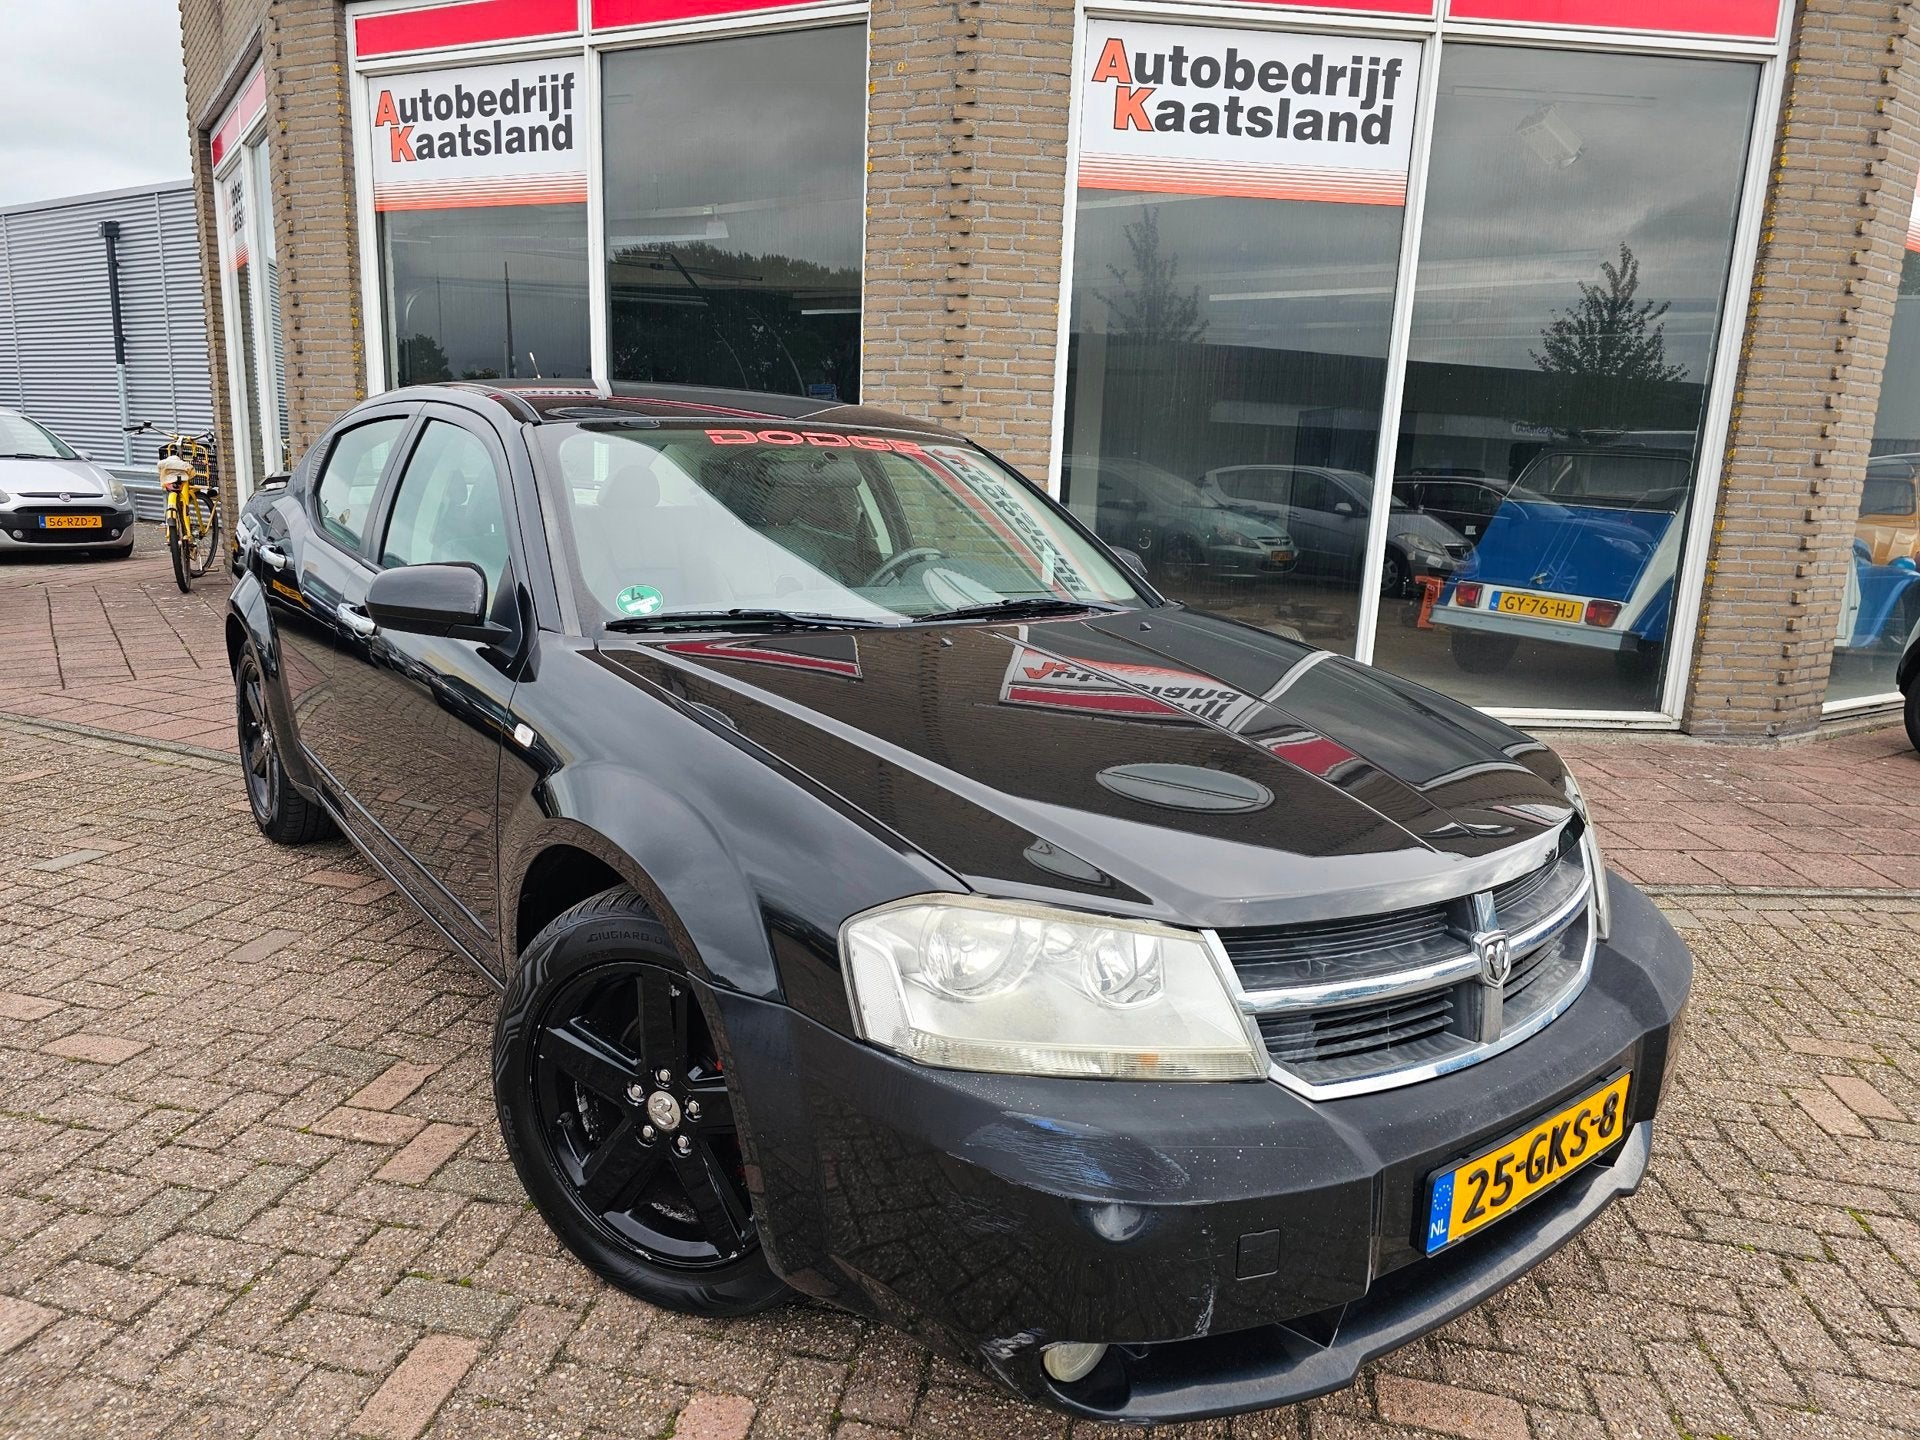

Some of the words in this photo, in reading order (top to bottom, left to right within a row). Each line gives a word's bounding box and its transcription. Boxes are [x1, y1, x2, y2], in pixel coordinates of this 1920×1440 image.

[1091, 38, 1402, 109] Autobedrijf
[375, 72, 575, 127] Autobedrijf
[1113, 85, 1393, 145] Kaatsland
[390, 114, 573, 162] Kaatsland
[704, 430, 925, 455] DODGE
[49, 517, 98, 527] 56-RZD-2
[1504, 596, 1576, 619] GY-76-HJ
[1430, 1218, 1446, 1239] NL
[1462, 1091, 1620, 1224] 25-GKS-8
